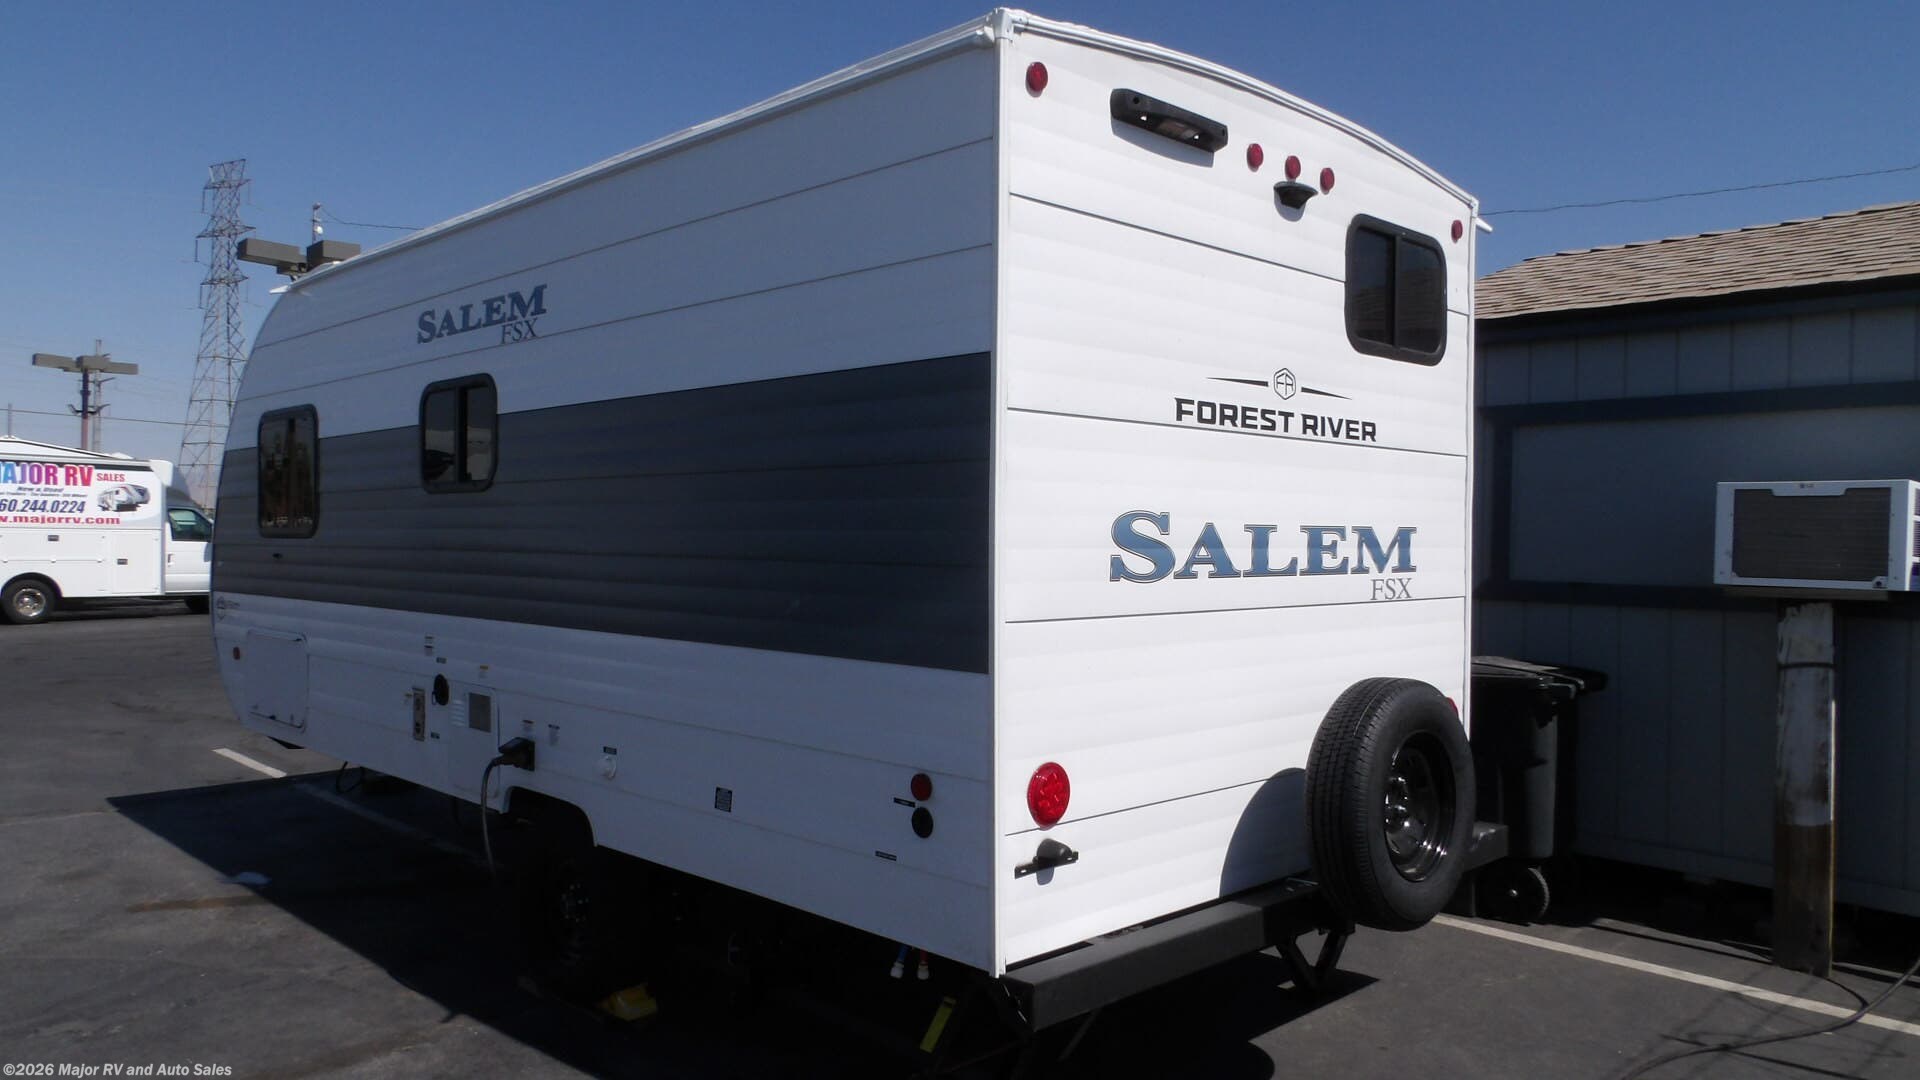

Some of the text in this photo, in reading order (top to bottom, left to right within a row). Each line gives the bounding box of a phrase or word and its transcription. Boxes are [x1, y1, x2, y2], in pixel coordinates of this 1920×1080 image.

[417, 283, 548, 344] SALEM
[501, 317, 538, 344] FSX
[1175, 397, 1377, 442] FOREST RIVER
[0, 461, 95, 487] AJOR RV
[96, 473, 126, 483] SALES
[1109, 509, 1417, 584] SALEM
[1370, 578, 1412, 600] FSX
